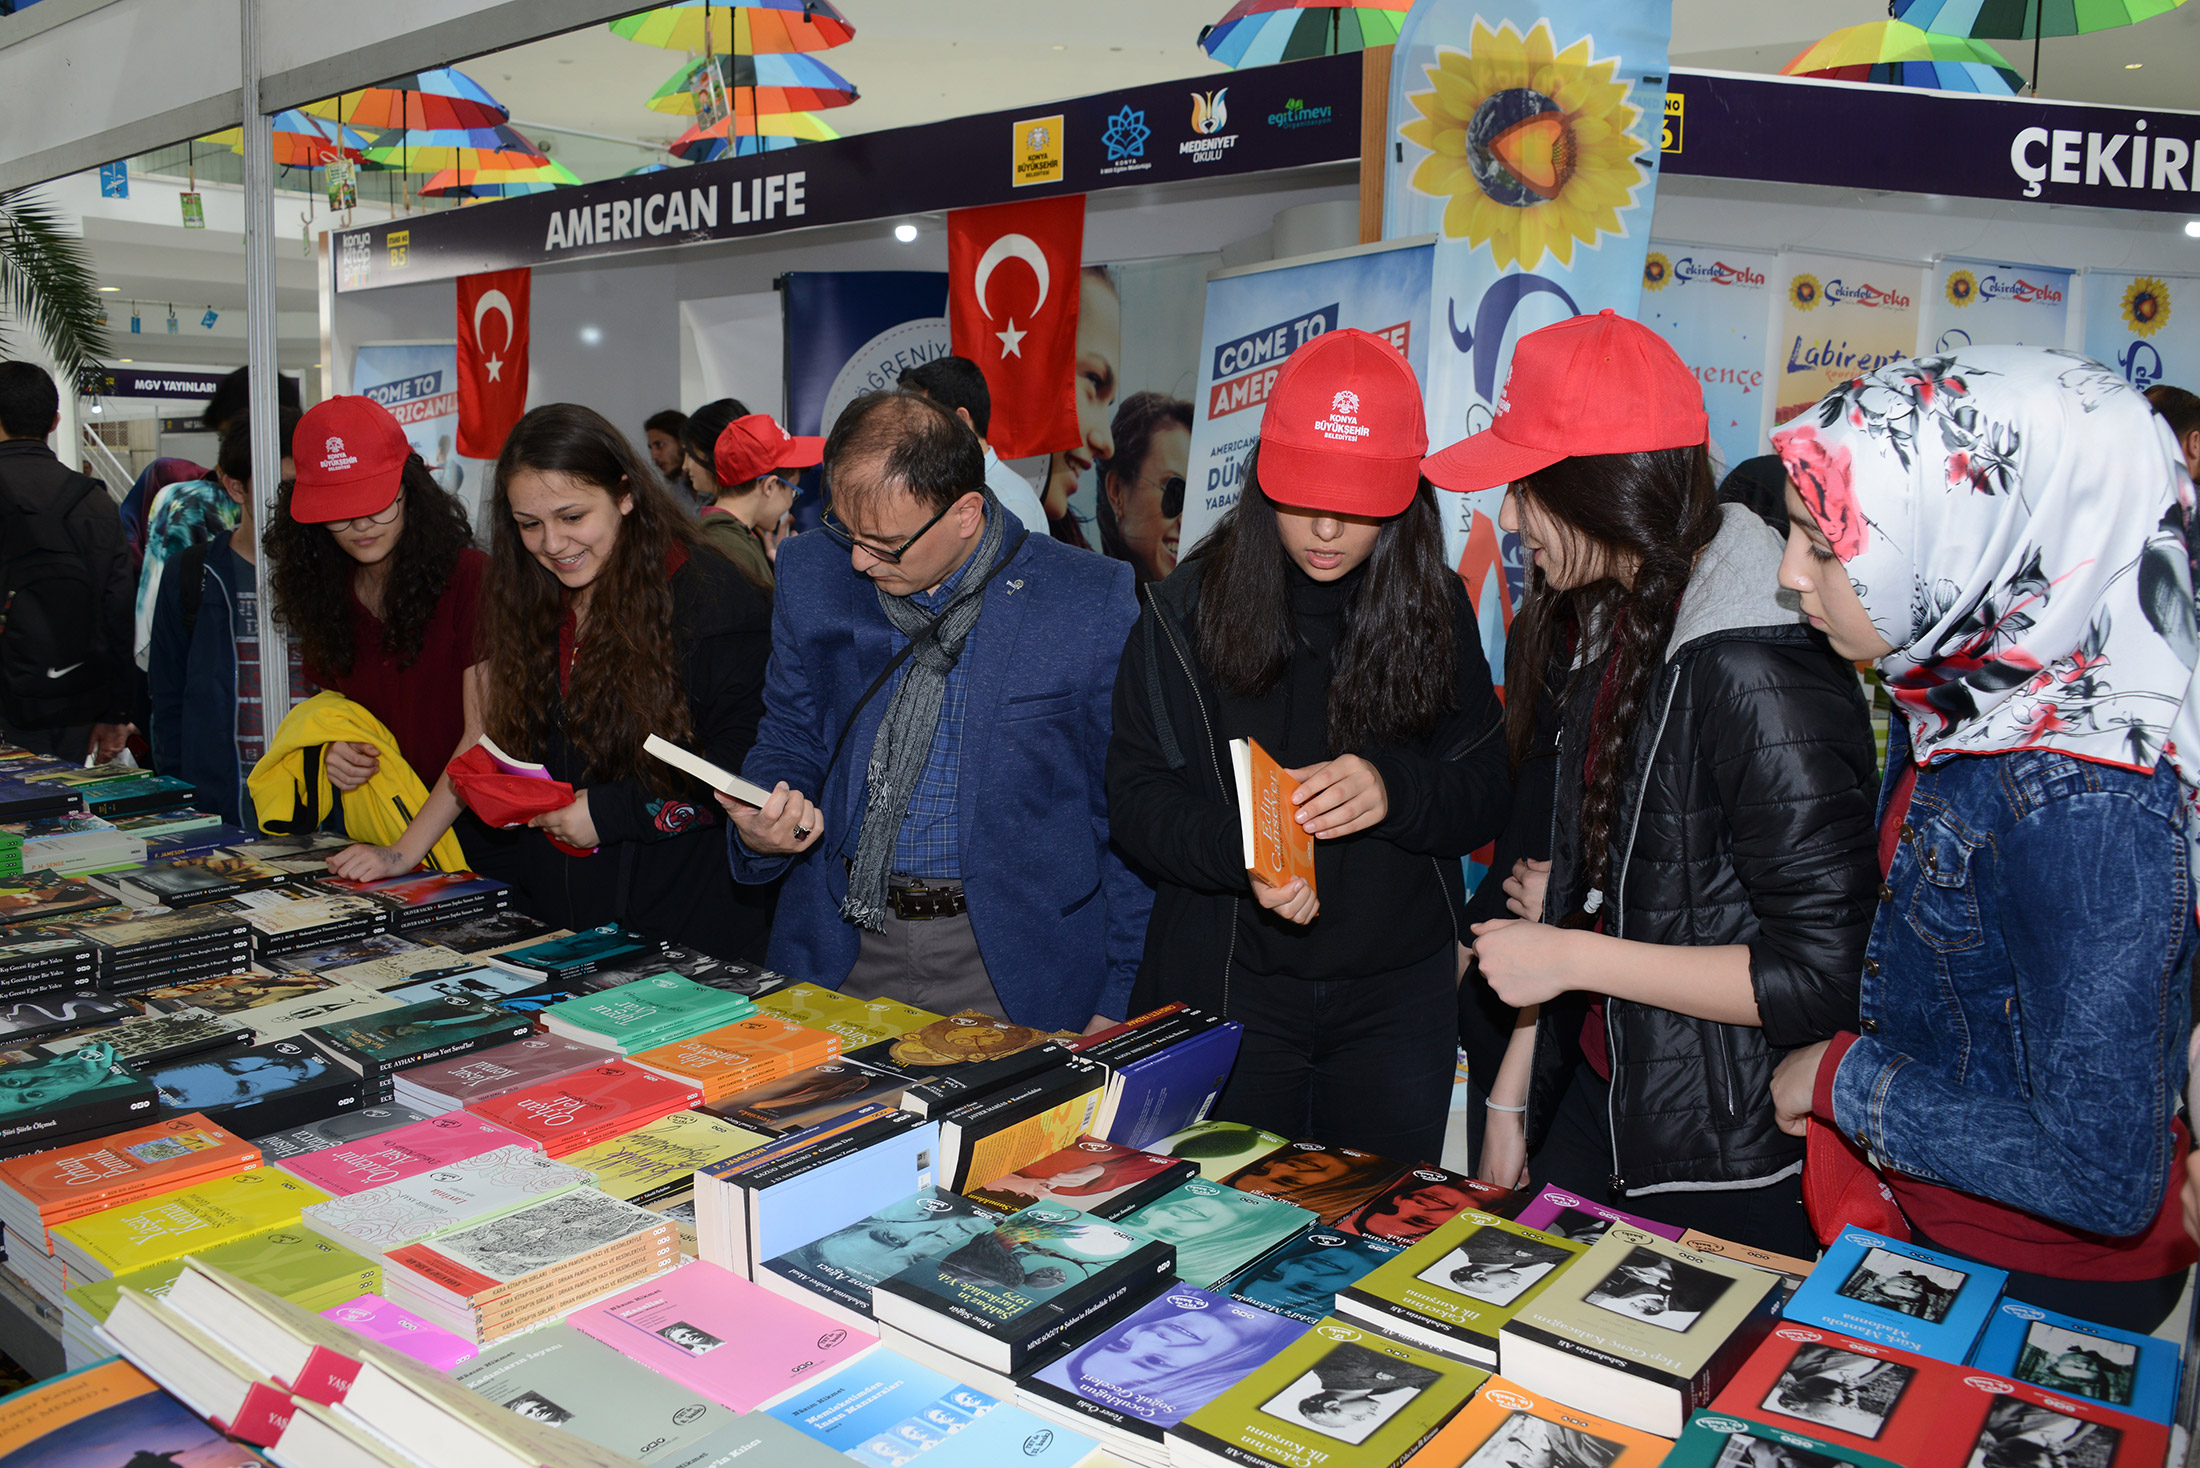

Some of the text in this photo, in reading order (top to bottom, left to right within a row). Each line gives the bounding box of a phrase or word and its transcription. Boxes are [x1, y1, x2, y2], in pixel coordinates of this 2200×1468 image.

[1028, 152, 1049, 162] KONYA
[1115, 158, 1137, 167] KONYA
[1193, 149, 1223, 164] OKULU
[2011, 118, 2200, 198] ÇEKİR
[545, 171, 806, 250] AMERICAN LIFE
[390, 247, 407, 267] B5
[1674, 257, 1725, 287] Çekirdek
[1711, 261, 1766, 286] Zeka
[1824, 279, 1872, 308] Çekirdek
[1857, 283, 1910, 308] Zeka
[1979, 275, 2027, 303] Çekirdek
[2013, 279, 2063, 303] Zeka
[1219, 313, 1327, 376] COME TO
[134, 379, 217, 393] MGV YAYINLARI
[367, 375, 435, 404] COME TO
[1314, 420, 1370, 437] BÜYÜKŞEHİR
[1329, 413, 1358, 426] KONYA
[1323, 432, 1359, 443] BELEDİYESİ
[327, 452, 347, 460] KONYA
[161, 848, 186, 858] JAMESON
[379, 1062, 393, 1072] ECE
[393, 1056, 416, 1069] AYHAN
[422, 1050, 439, 1061] Bütün
[677, 1051, 718, 1069] Edip
[678, 1040, 750, 1067] Cansever
[379, 1079, 393, 1087] ECE
[380, 1095, 393, 1103] ECE
[552, 1094, 587, 1115] Veli
[517, 1098, 575, 1127] Orhan
[968, 1111, 987, 1121] JAVIER
[2, 1119, 58, 1138] Şiiri Şiirle Ölçmek
[53, 1156, 102, 1187] Orhan
[88, 1148, 139, 1180] Pamuk
[332, 1149, 401, 1184] Özdemir
[713, 1162, 724, 1170] F.
[723, 1147, 767, 1167] JAMESON
[753, 1166, 779, 1180] KAZUO
[431, 1188, 467, 1205] Lavinia
[492, 1285, 507, 1295] KARA
[529, 1271, 548, 1283] SIRLARI
[551, 1263, 569, 1274] ORHAN
[568, 1254, 592, 1270] PAMUK'UN
[592, 1250, 604, 1261] YAZI
[603, 1248, 610, 1256] VE
[610, 1234, 642, 1252] RESİMLERİYLE
[500, 1297, 516, 1307] KARA
[535, 1283, 555, 1295] SIRLARI
[558, 1275, 575, 1285] ORHAN
[574, 1266, 598, 1281] PAMUK'UN
[598, 1261, 609, 1271] YAZI
[609, 1258, 616, 1267] VE
[615, 1244, 647, 1263] RESİMLERİYLE
[816, 1262, 851, 1282] Ağacı
[500, 1309, 516, 1319] KARA
[535, 1294, 555, 1308] SIRLARI
[558, 1286, 575, 1297] ORHAN
[574, 1277, 598, 1293] PAMUK'UN
[598, 1272, 609, 1283] YAZI
[609, 1269, 616, 1278] VE
[615, 1255, 647, 1274] RESİMLERİYLE
[501, 1321, 517, 1331] KARA
[537, 1306, 556, 1319] SIRLARI
[559, 1298, 576, 1309] ORHAN
[575, 1289, 599, 1305] PAMUK'UN
[599, 1283, 610, 1294] YAZI
[610, 1281, 617, 1289] VE
[616, 1266, 649, 1285] RESİMLERİYLE
[633, 1289, 662, 1303] Hikmet
[787, 1267, 870, 1310] Sabahattin Kudret Aksal
[1002, 1290, 1035, 1308] 1979
[620, 1297, 665, 1318] Masallar
[1229, 1292, 1286, 1316] Mektuplar
[1402, 1295, 1467, 1324] Çakıcı'nın
[1405, 1288, 1481, 1321] İlk Kurşunu
[949, 1305, 996, 1331] Mine Söğüt
[1026, 1338, 1042, 1351] MİNE
[1041, 1326, 1060, 1344] SÖĞÜT
[1116, 1286, 1127, 1298] 1979
[1327, 1325, 1352, 1337] baskı
[1390, 1304, 1453, 1332] Sabahattin Ali
[1842, 1312, 1911, 1339] Madonna
[1532, 1312, 1684, 1370] Hep Genç Kalacağım
[1822, 1314, 1922, 1352] Kürk Mantolu
[484, 1351, 516, 1368] Hikmet
[1556, 1339, 1629, 1368] Sabahattin Ali
[804, 1380, 884, 1425] Memleketimden
[815, 1379, 905, 1430] İnsan Manzaraları
[816, 1387, 846, 1405] Hikmet
[1076, 1399, 1100, 1413] Özlü
[1079, 1383, 1157, 1418] Çocukluğun
[1080, 1373, 1177, 1415] Soğuk Geceleri
[1224, 1446, 1244, 1458] Ali
[1245, 1424, 1306, 1454] Kurşunu
